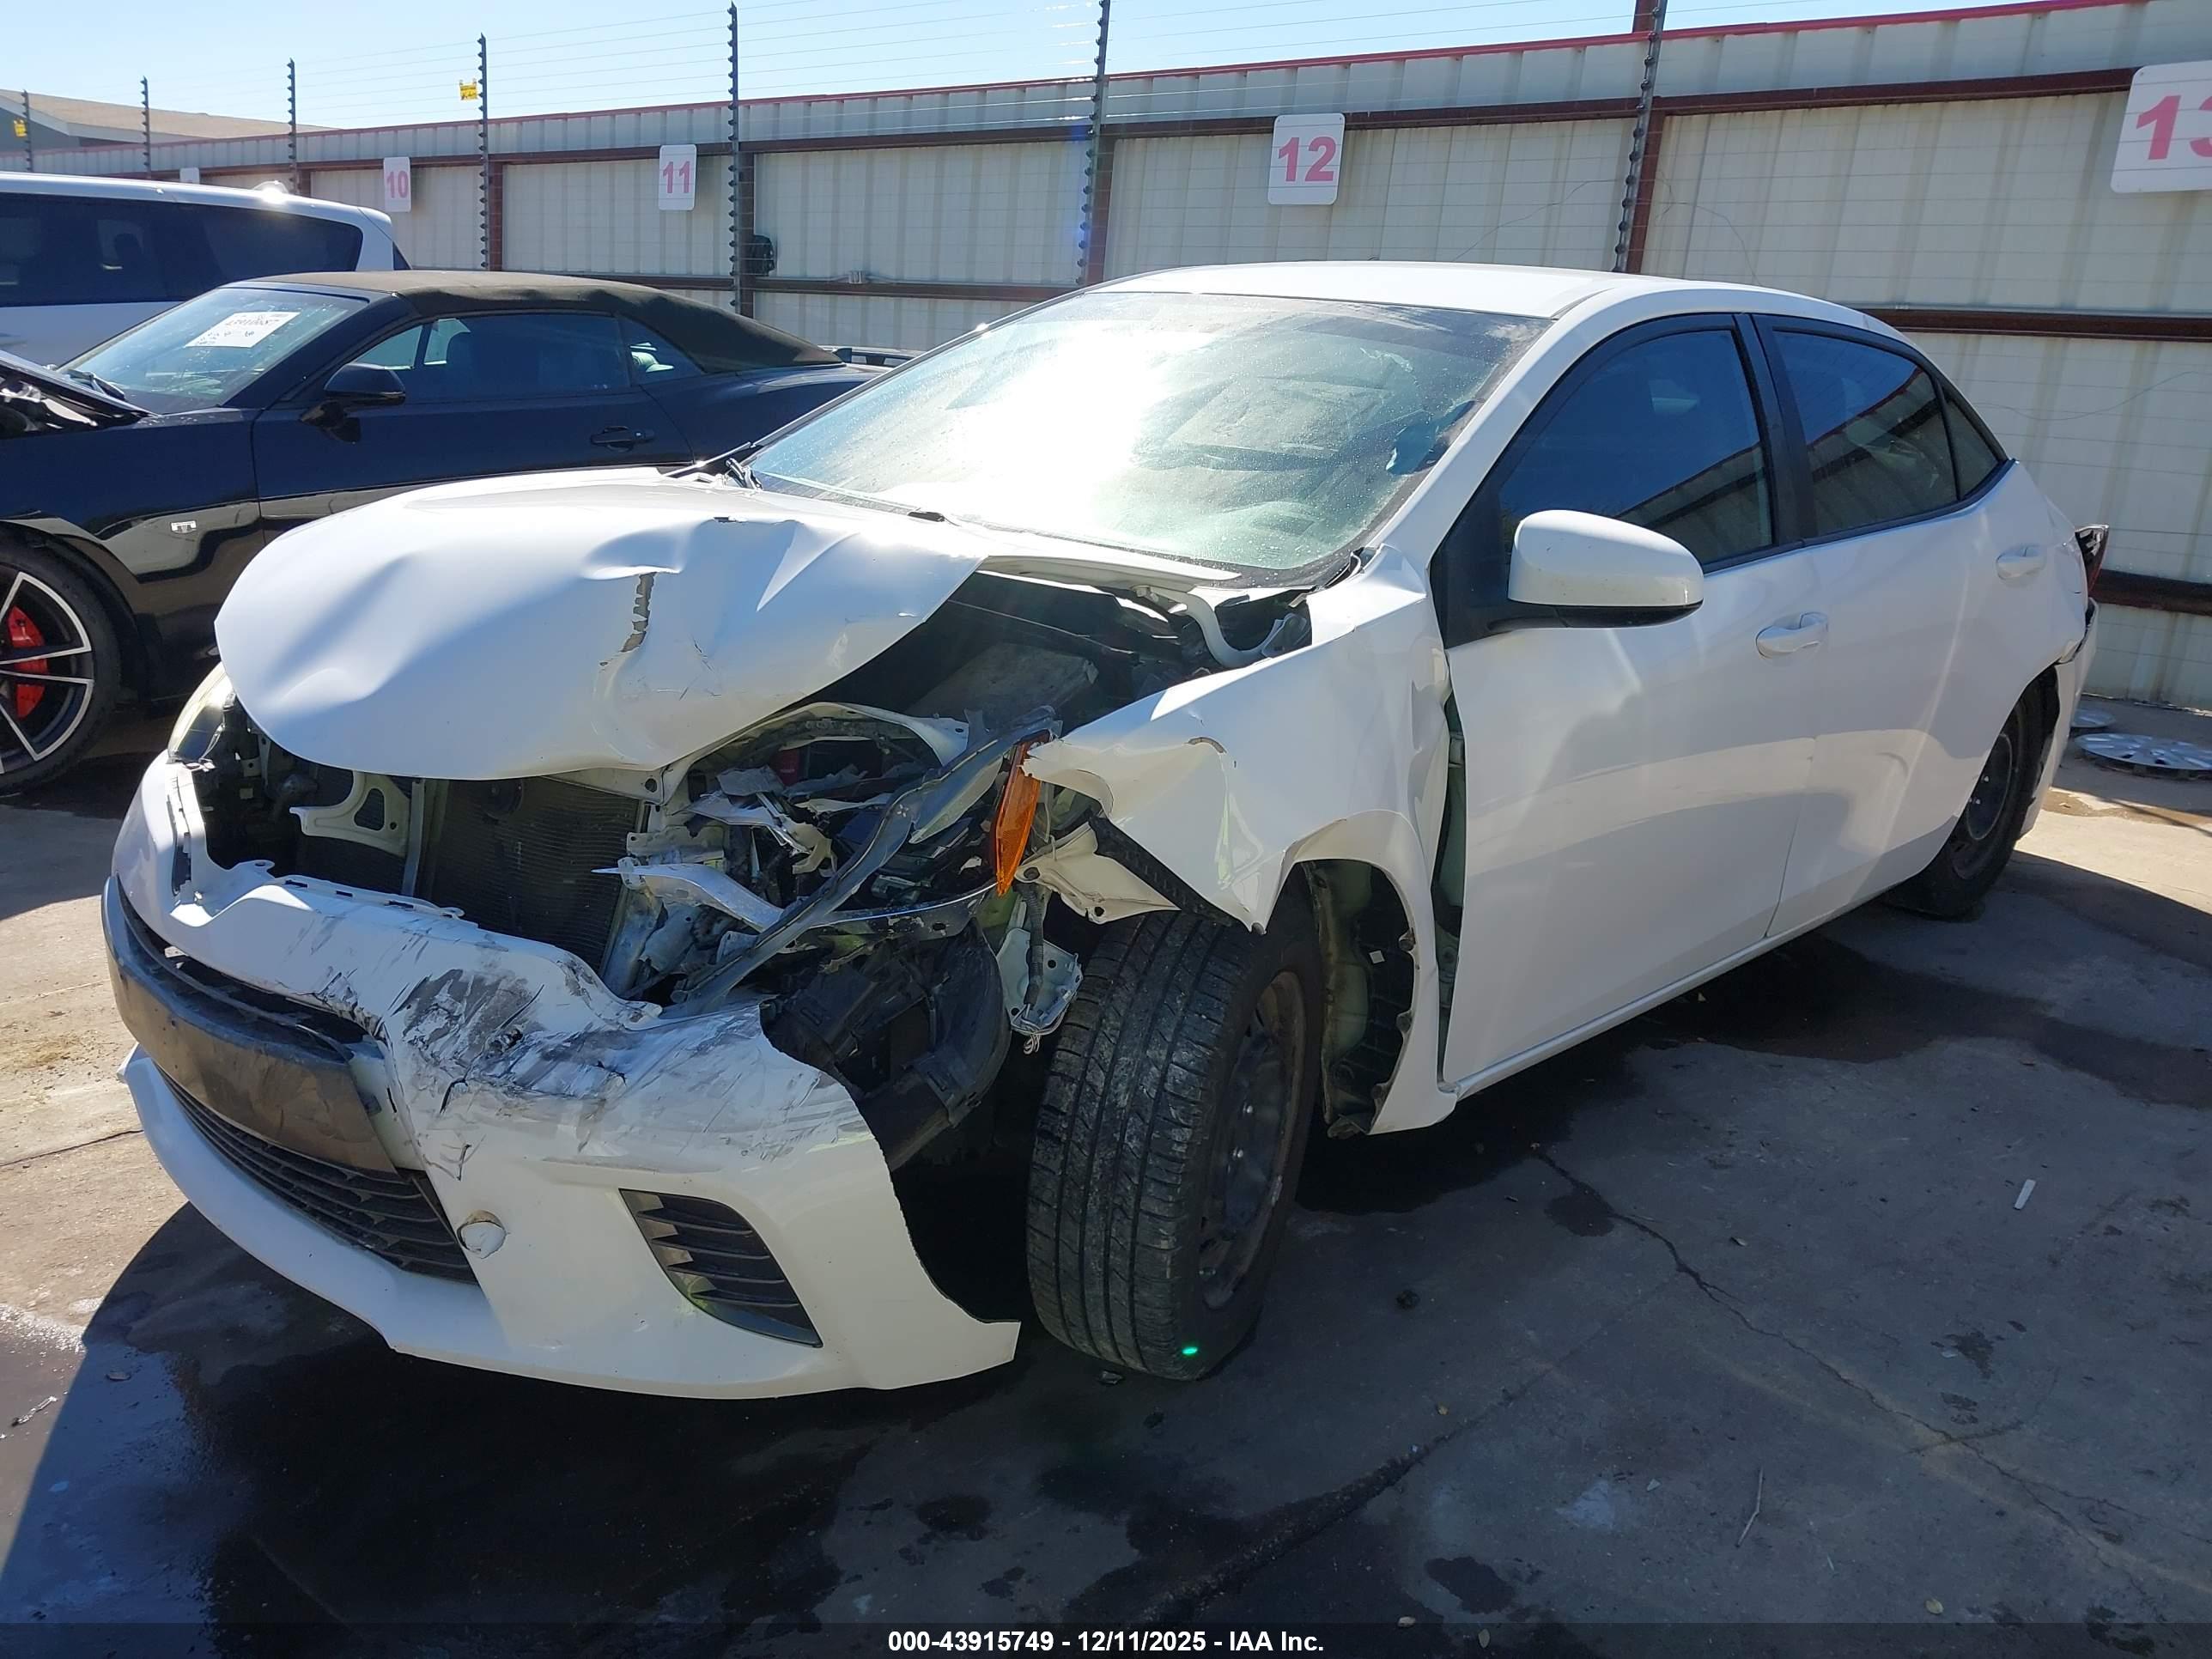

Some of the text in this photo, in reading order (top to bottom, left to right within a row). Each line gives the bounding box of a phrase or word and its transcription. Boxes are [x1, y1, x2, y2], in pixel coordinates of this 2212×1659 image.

[1278, 137, 1336, 181] 12
[387, 171, 408, 198] 10
[663, 161, 690, 193] 11
